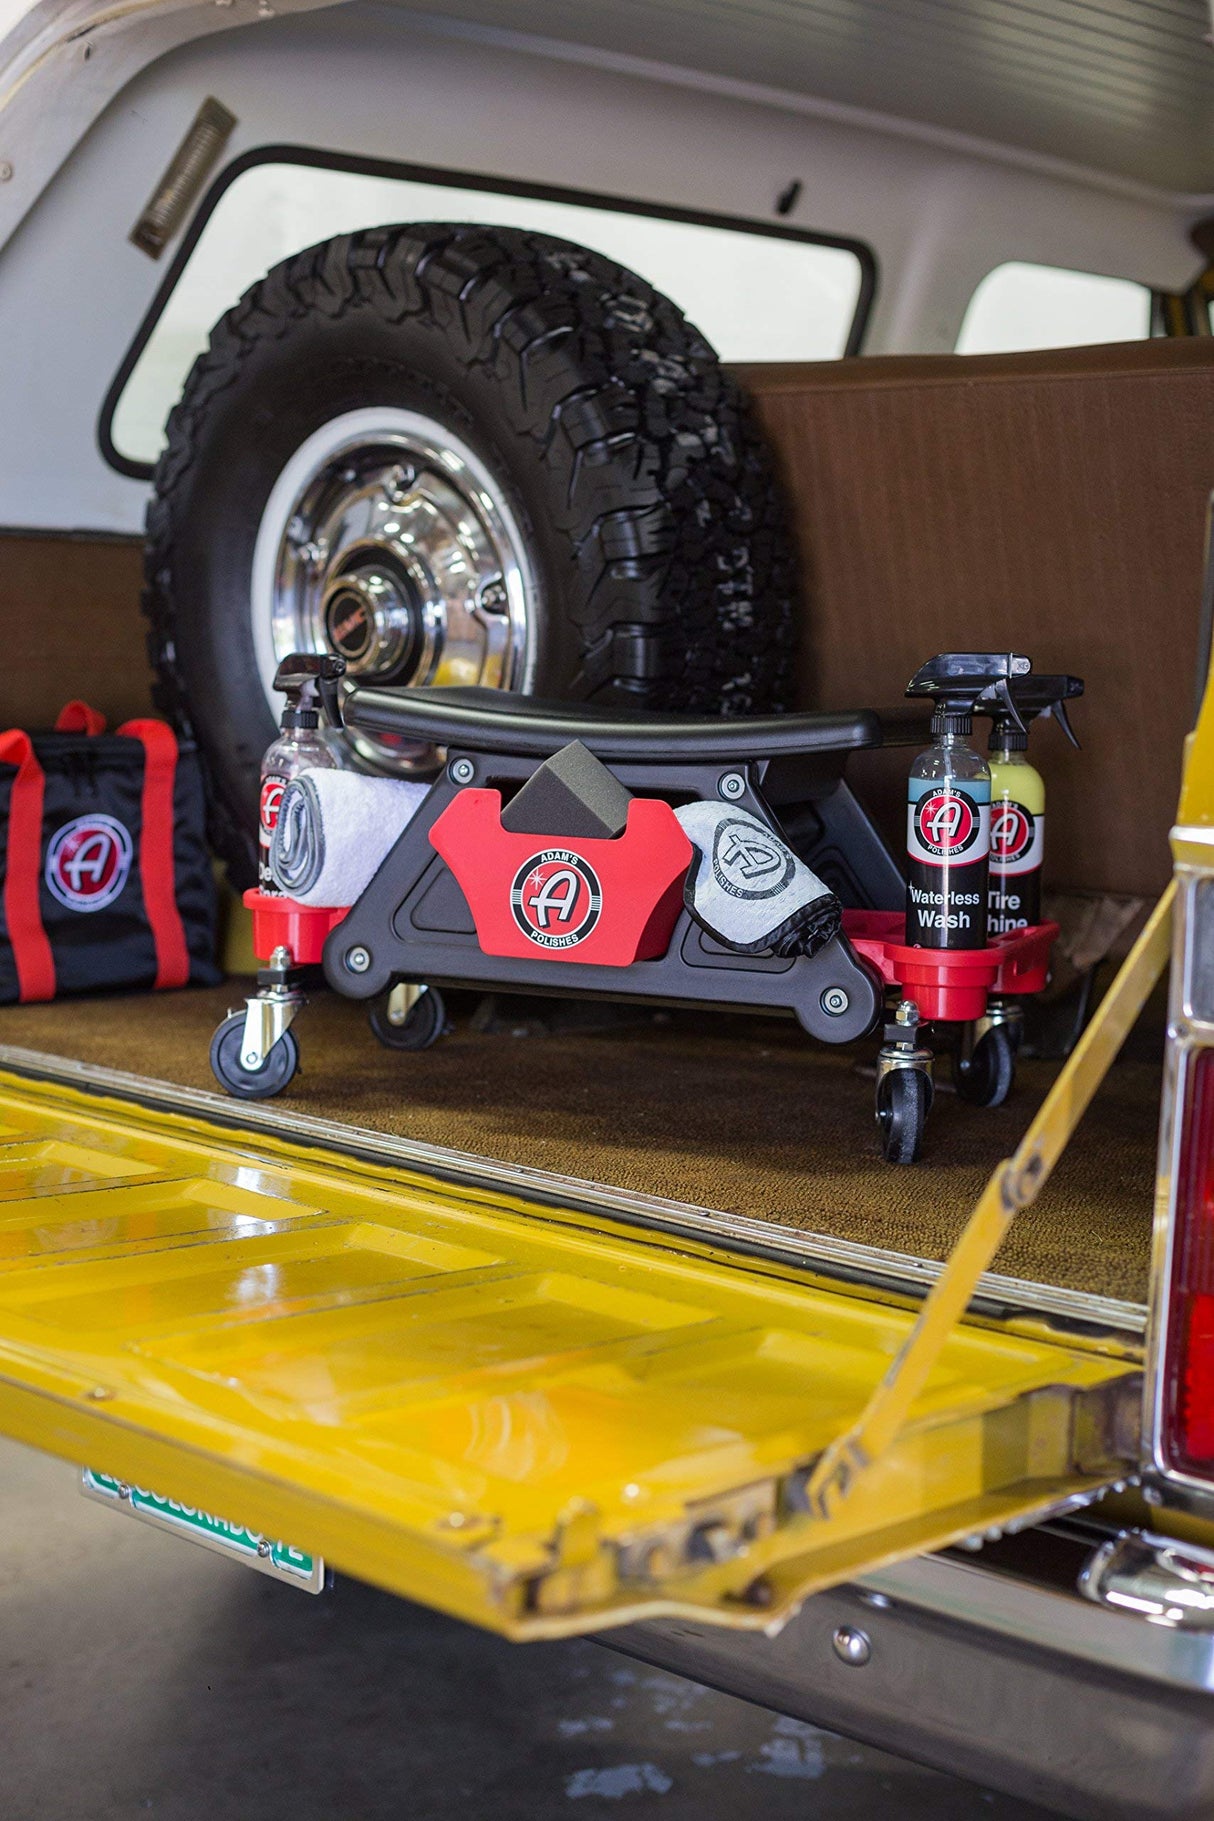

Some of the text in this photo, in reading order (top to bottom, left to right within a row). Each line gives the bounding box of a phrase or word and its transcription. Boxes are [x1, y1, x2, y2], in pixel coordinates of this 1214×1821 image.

[932, 788, 962, 798] ADAM'S
[927, 801, 961, 842] A
[990, 813, 1019, 850] A
[541, 851, 579, 865] ADAM'S
[927, 844, 964, 855] POLISHES
[63, 833, 111, 890] A
[713, 858, 744, 897] POLISHES
[529, 869, 579, 928] A
[911, 890, 980, 906] Waterless
[918, 910, 971, 929] Wash
[988, 915, 1028, 933] hine
[530, 930, 579, 947] POLISHES
